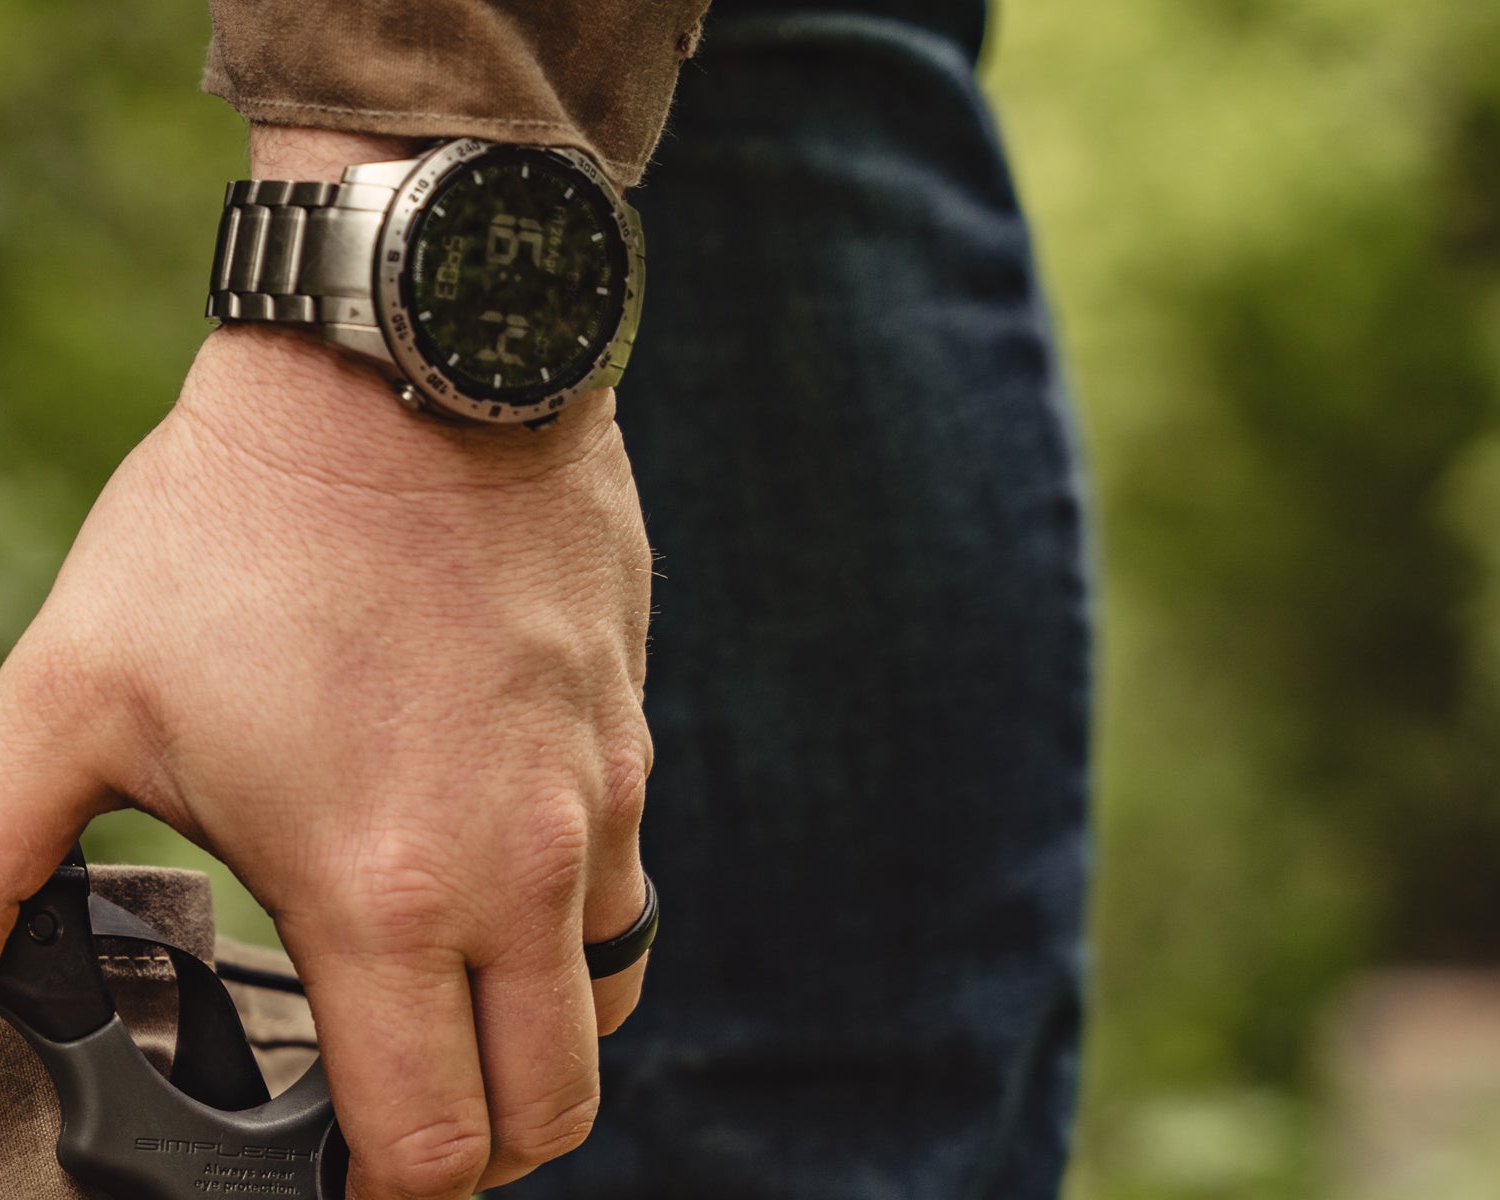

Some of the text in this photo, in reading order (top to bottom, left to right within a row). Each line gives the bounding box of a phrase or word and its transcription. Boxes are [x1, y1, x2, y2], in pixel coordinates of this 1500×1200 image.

[456, 140, 481, 157] 240
[577, 157, 597, 179] 300
[409, 179, 430, 203] 210
[617, 211, 630, 240] 330
[134, 1135, 319, 1163] SIMPLESH
[203, 1163, 296, 1181] Always wear
[194, 1178, 301, 1196] eye protection.
